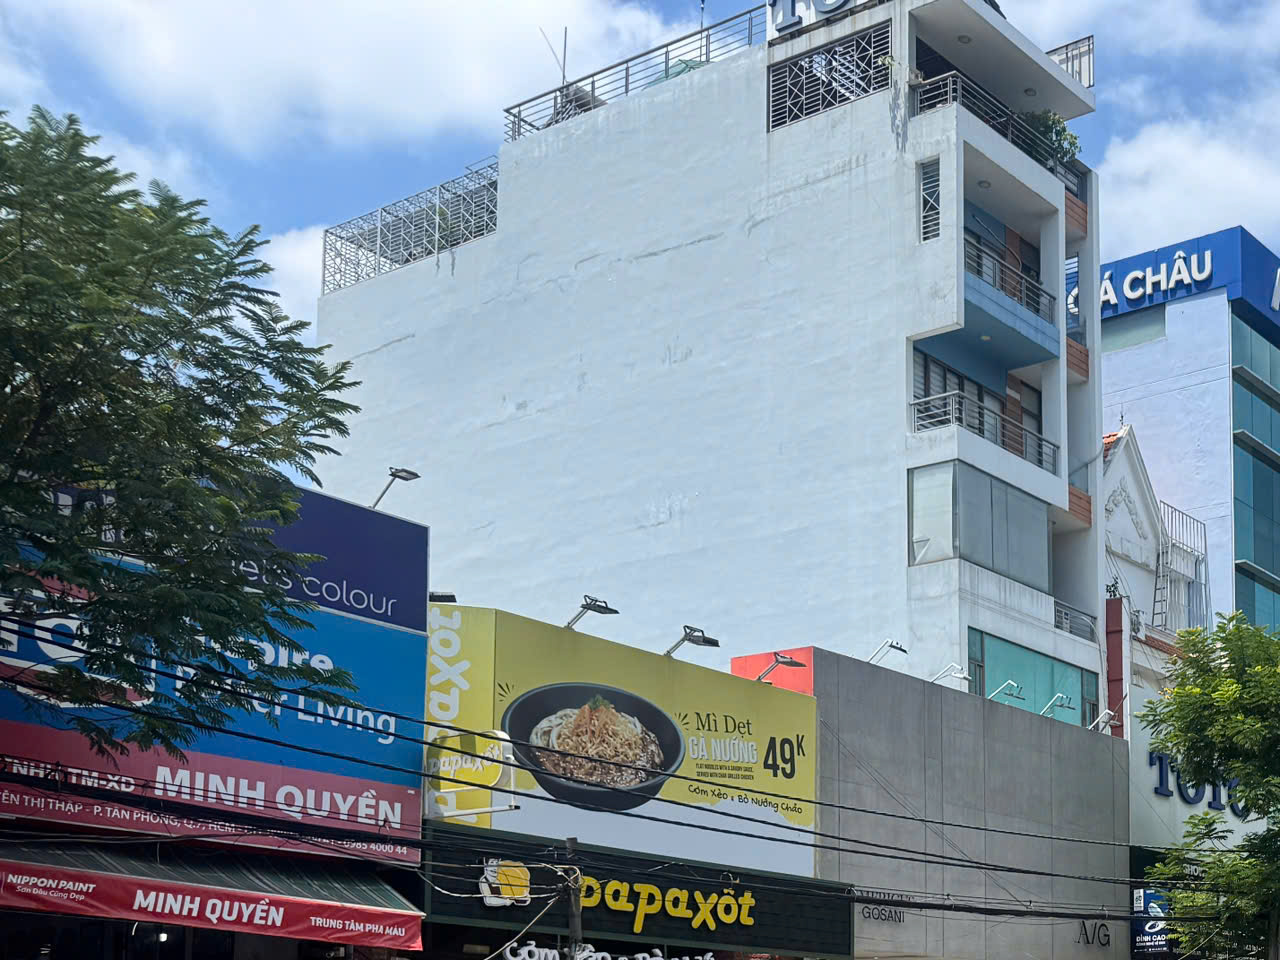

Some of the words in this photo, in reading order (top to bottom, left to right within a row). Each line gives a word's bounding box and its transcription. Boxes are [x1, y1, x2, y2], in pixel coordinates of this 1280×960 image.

[1123, 250, 1212, 300] CHÂU
[303, 576, 398, 617] colour
[297, 694, 397, 743] Living
[695, 711, 719, 733] Mì
[723, 714, 753, 739] Dẹt
[688, 732, 709, 761] GÀ
[154, 765, 266, 811] MINH
[275, 785, 402, 830] QUYỀN
[710, 788, 729, 799] Xèo
[738, 794, 750, 804] Bò
[781, 802, 803, 814] Chảo
[23, 795, 45, 812] THỊ
[369, 842, 394, 854] 4000
[395, 845, 408, 855] 44
[7, 873, 58, 889] NIPPON
[58, 880, 97, 893] PAINT
[133, 889, 201, 918] MINH
[205, 897, 285, 927] QUYỀN
[861, 905, 905, 923] GOSANI
[310, 916, 343, 930] TRUNG
[344, 918, 364, 932] TÂM
[365, 924, 384, 934] PHA
